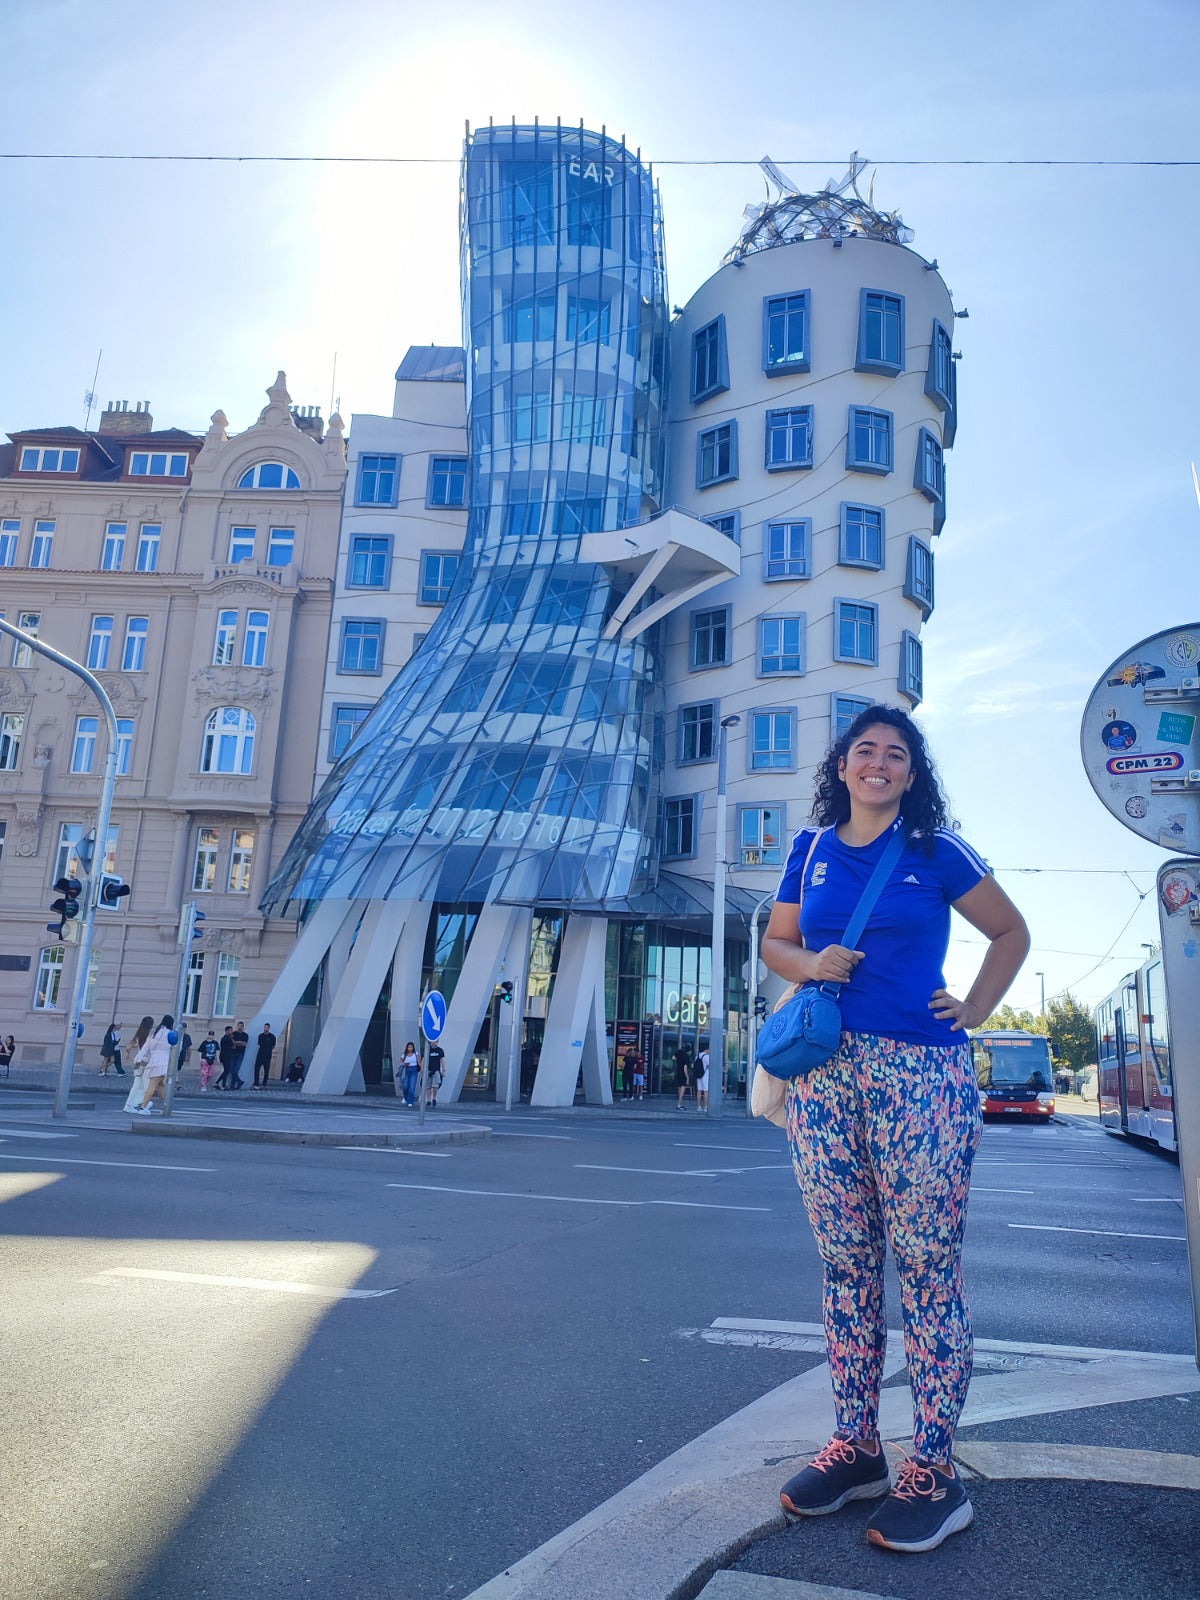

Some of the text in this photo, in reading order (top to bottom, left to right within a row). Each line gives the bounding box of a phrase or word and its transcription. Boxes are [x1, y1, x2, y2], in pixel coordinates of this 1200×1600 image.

[1116, 757, 1173, 770] CPM 22
[667, 990, 708, 1025] Café
